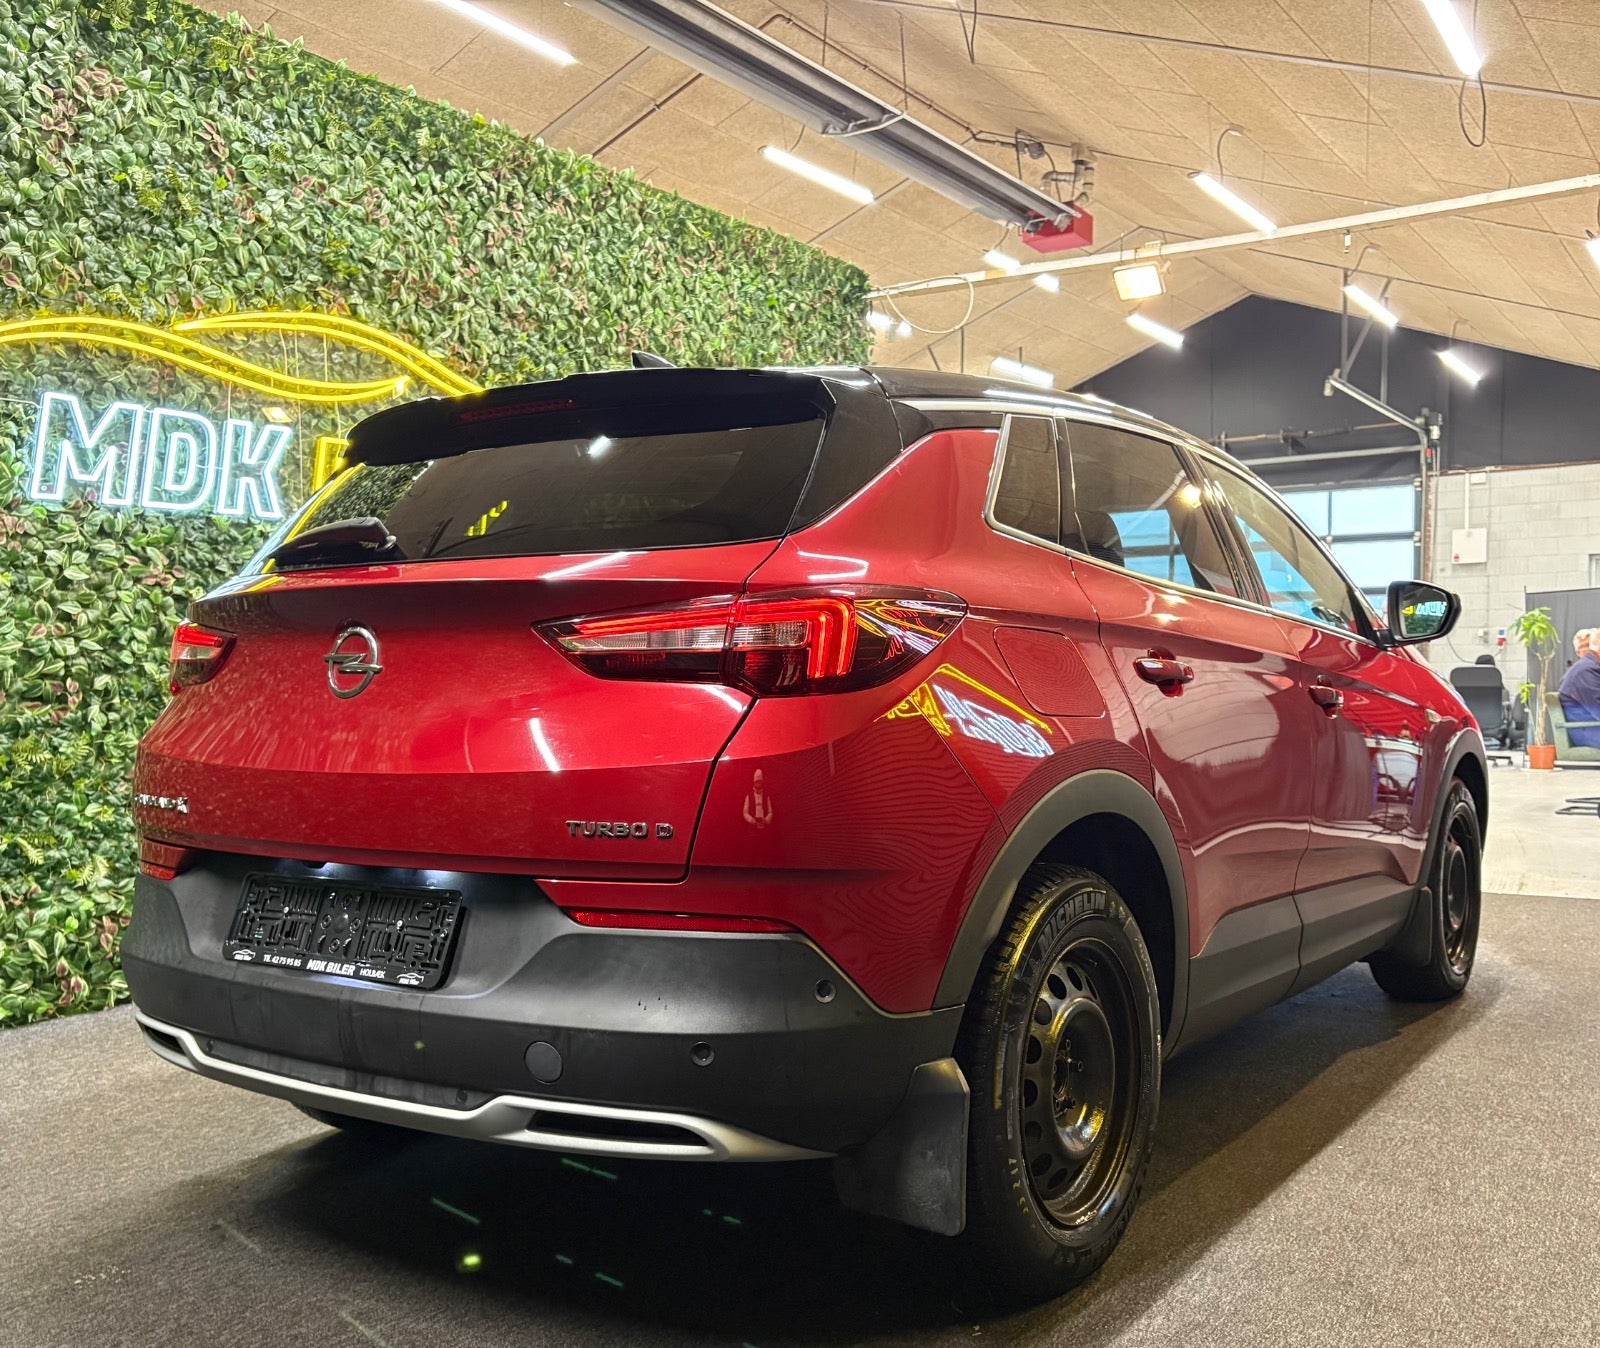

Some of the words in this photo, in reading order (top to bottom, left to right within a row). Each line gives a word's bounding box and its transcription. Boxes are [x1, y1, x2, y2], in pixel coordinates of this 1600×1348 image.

[29, 391, 292, 520] MDK
[565, 820, 648, 837] TURBO
[656, 822, 673, 837] D
[1038, 892, 1106, 960] MICHELIN
[306, 959, 327, 971] MDK
[326, 962, 355, 976] BILER
